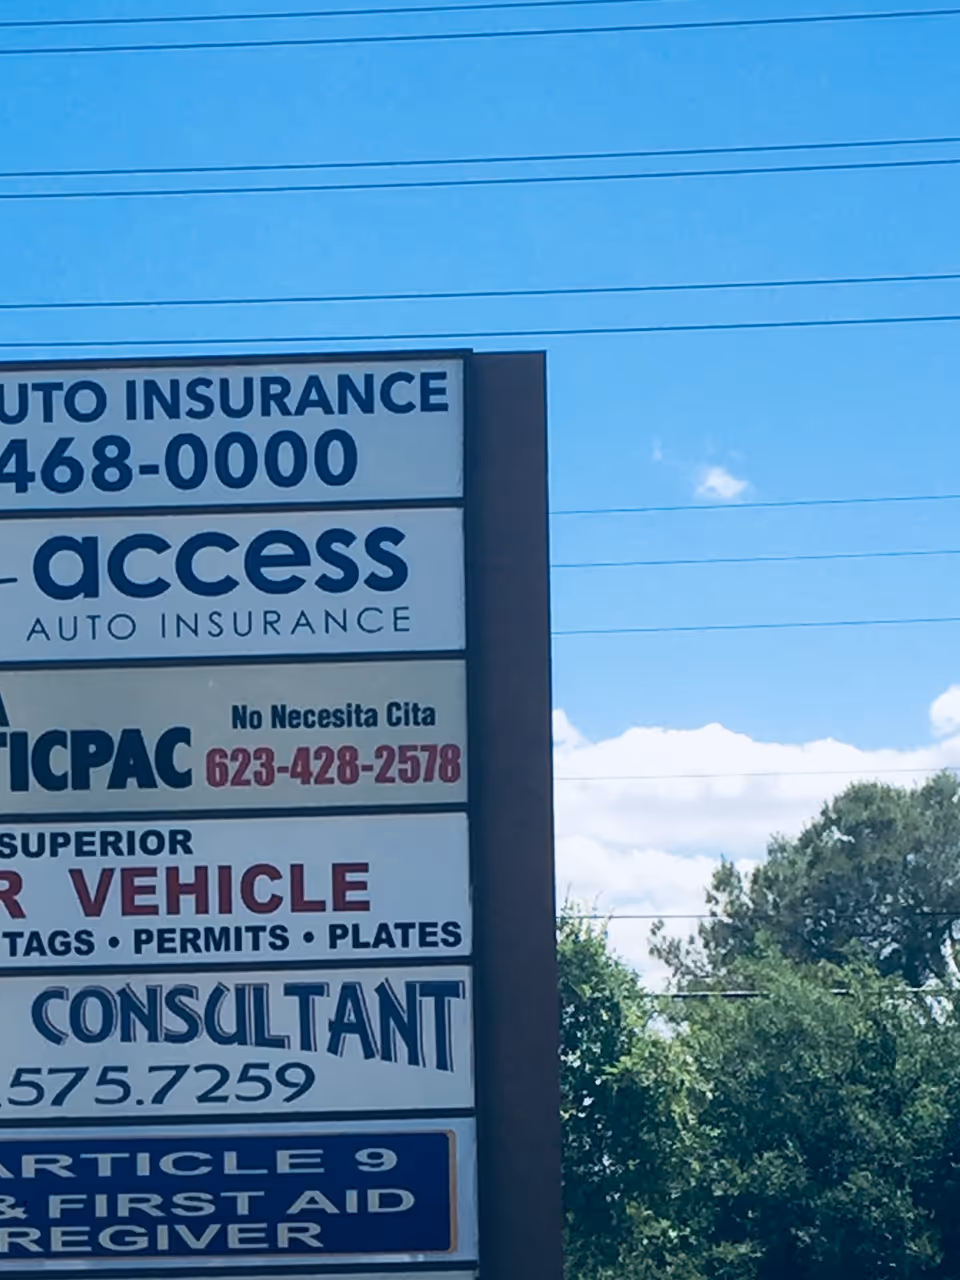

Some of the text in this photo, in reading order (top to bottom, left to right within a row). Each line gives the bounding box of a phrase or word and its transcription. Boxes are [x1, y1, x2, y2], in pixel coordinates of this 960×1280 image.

[126, 372, 448, 420] INSURANCE
[33, 527, 408, 600] access
[27, 606, 411, 642] AUTO INSURANCE
[232, 701, 436, 730] No Necesita Cita
[206, 744, 461, 787] 623-428-2578
[68, 863, 370, 917] VEHICLE
[2, 930, 94, 957] TAGS
[134, 925, 289, 955] PERMITS
[329, 922, 462, 949] PLATES
[30, 977, 464, 1072] CONSULTANT
[355, 1148, 397, 1171] 9
[49, 1191, 264, 1218] FIRST
[287, 1189, 414, 1214] AID
